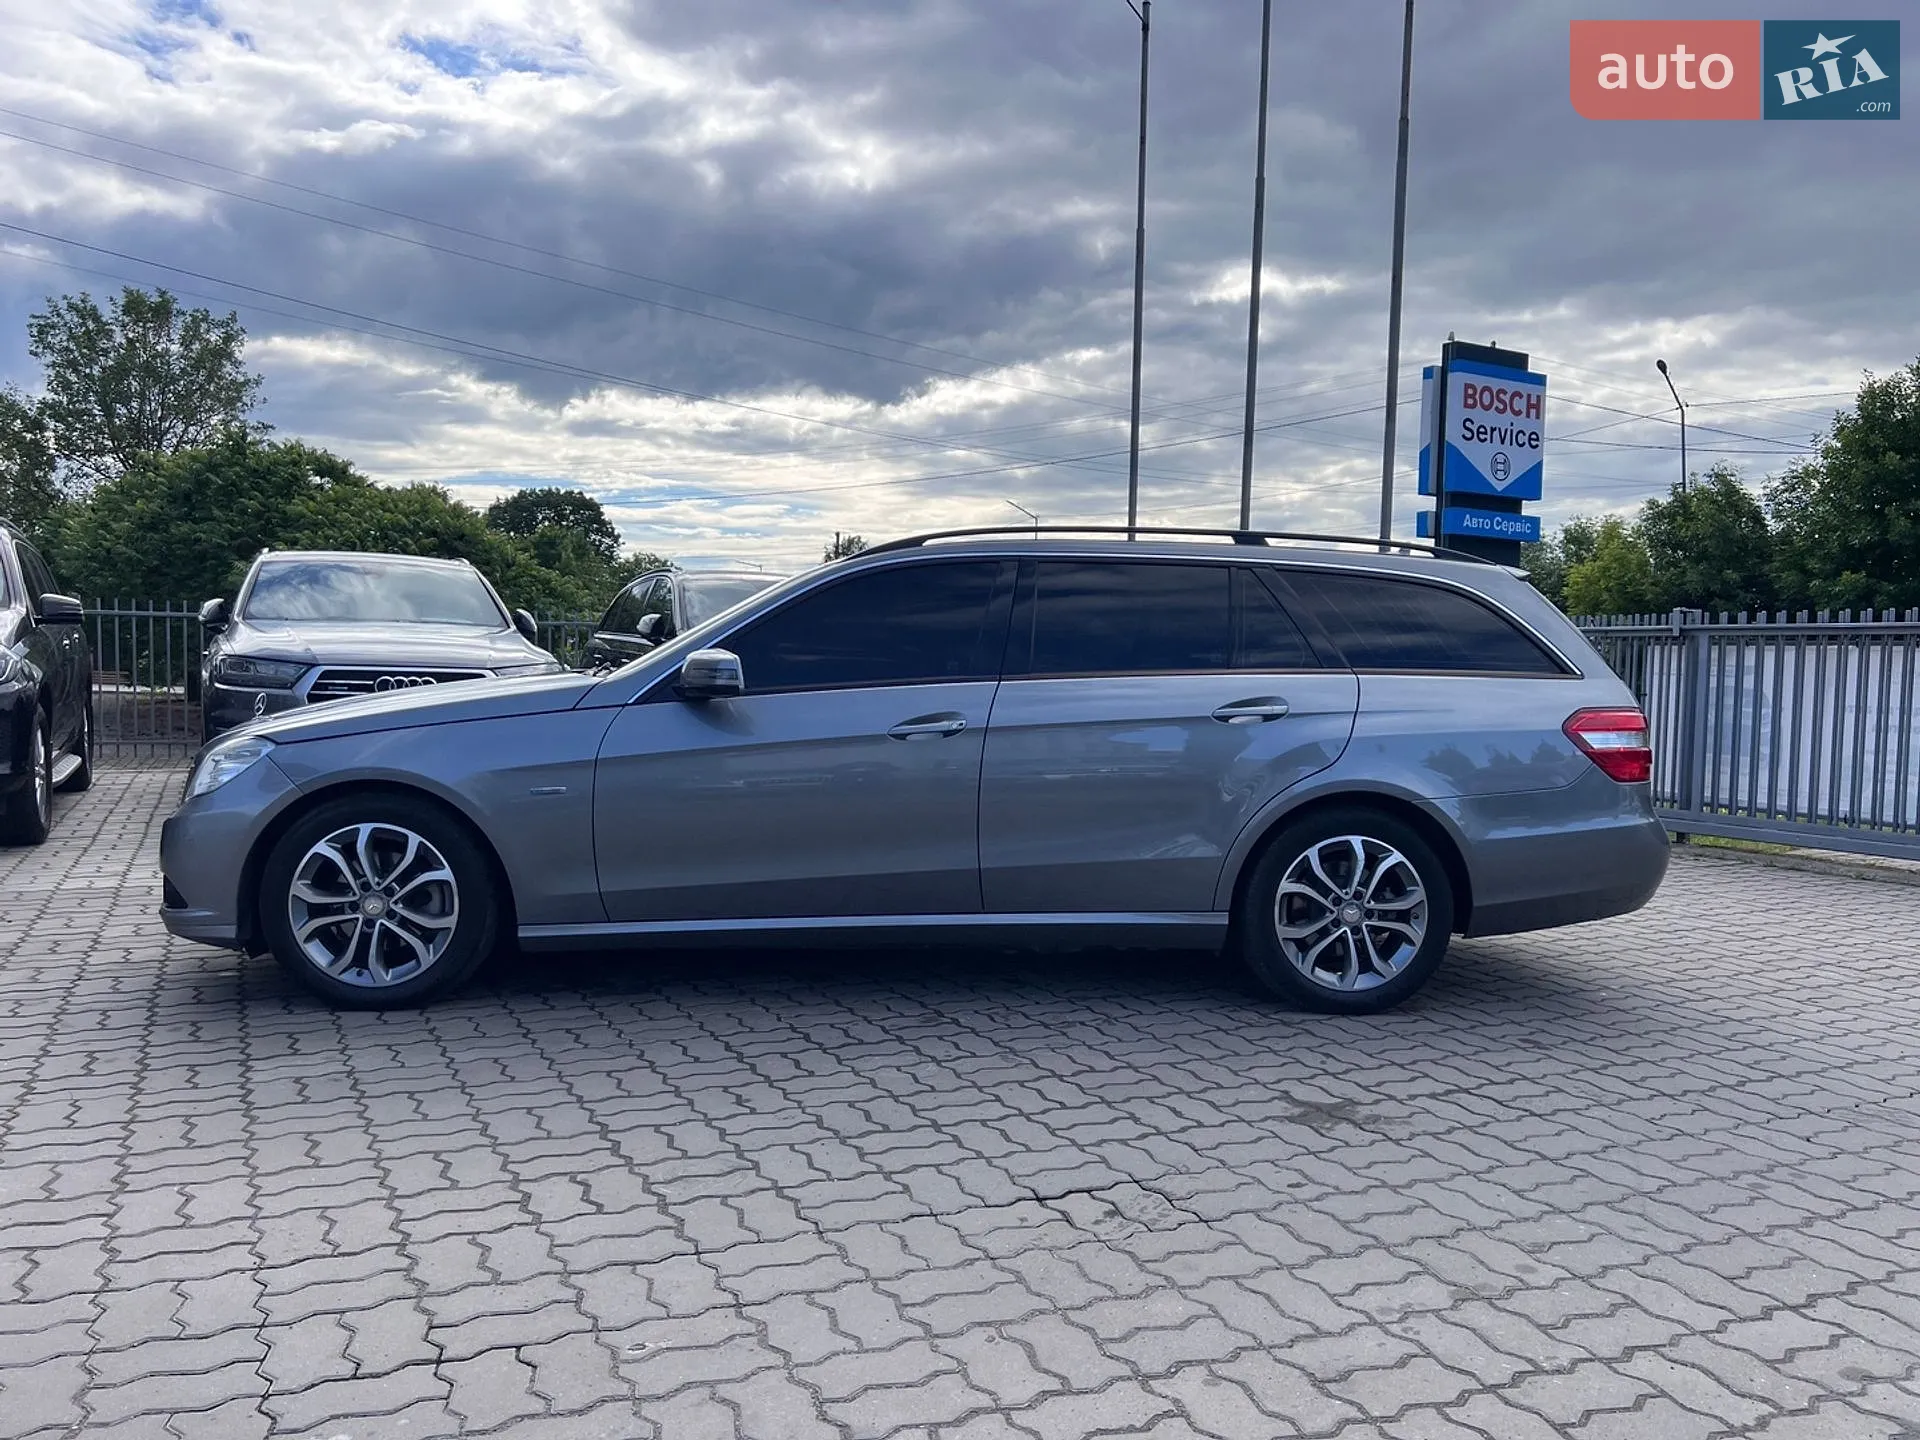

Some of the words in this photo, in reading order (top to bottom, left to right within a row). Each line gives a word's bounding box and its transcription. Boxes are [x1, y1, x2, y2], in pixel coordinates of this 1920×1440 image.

[1463, 382, 1541, 420] BOSCH
[1461, 417, 1540, 449] Service
[1463, 514, 1491, 529] Авто
[1494, 517, 1531, 534] Сервіс
